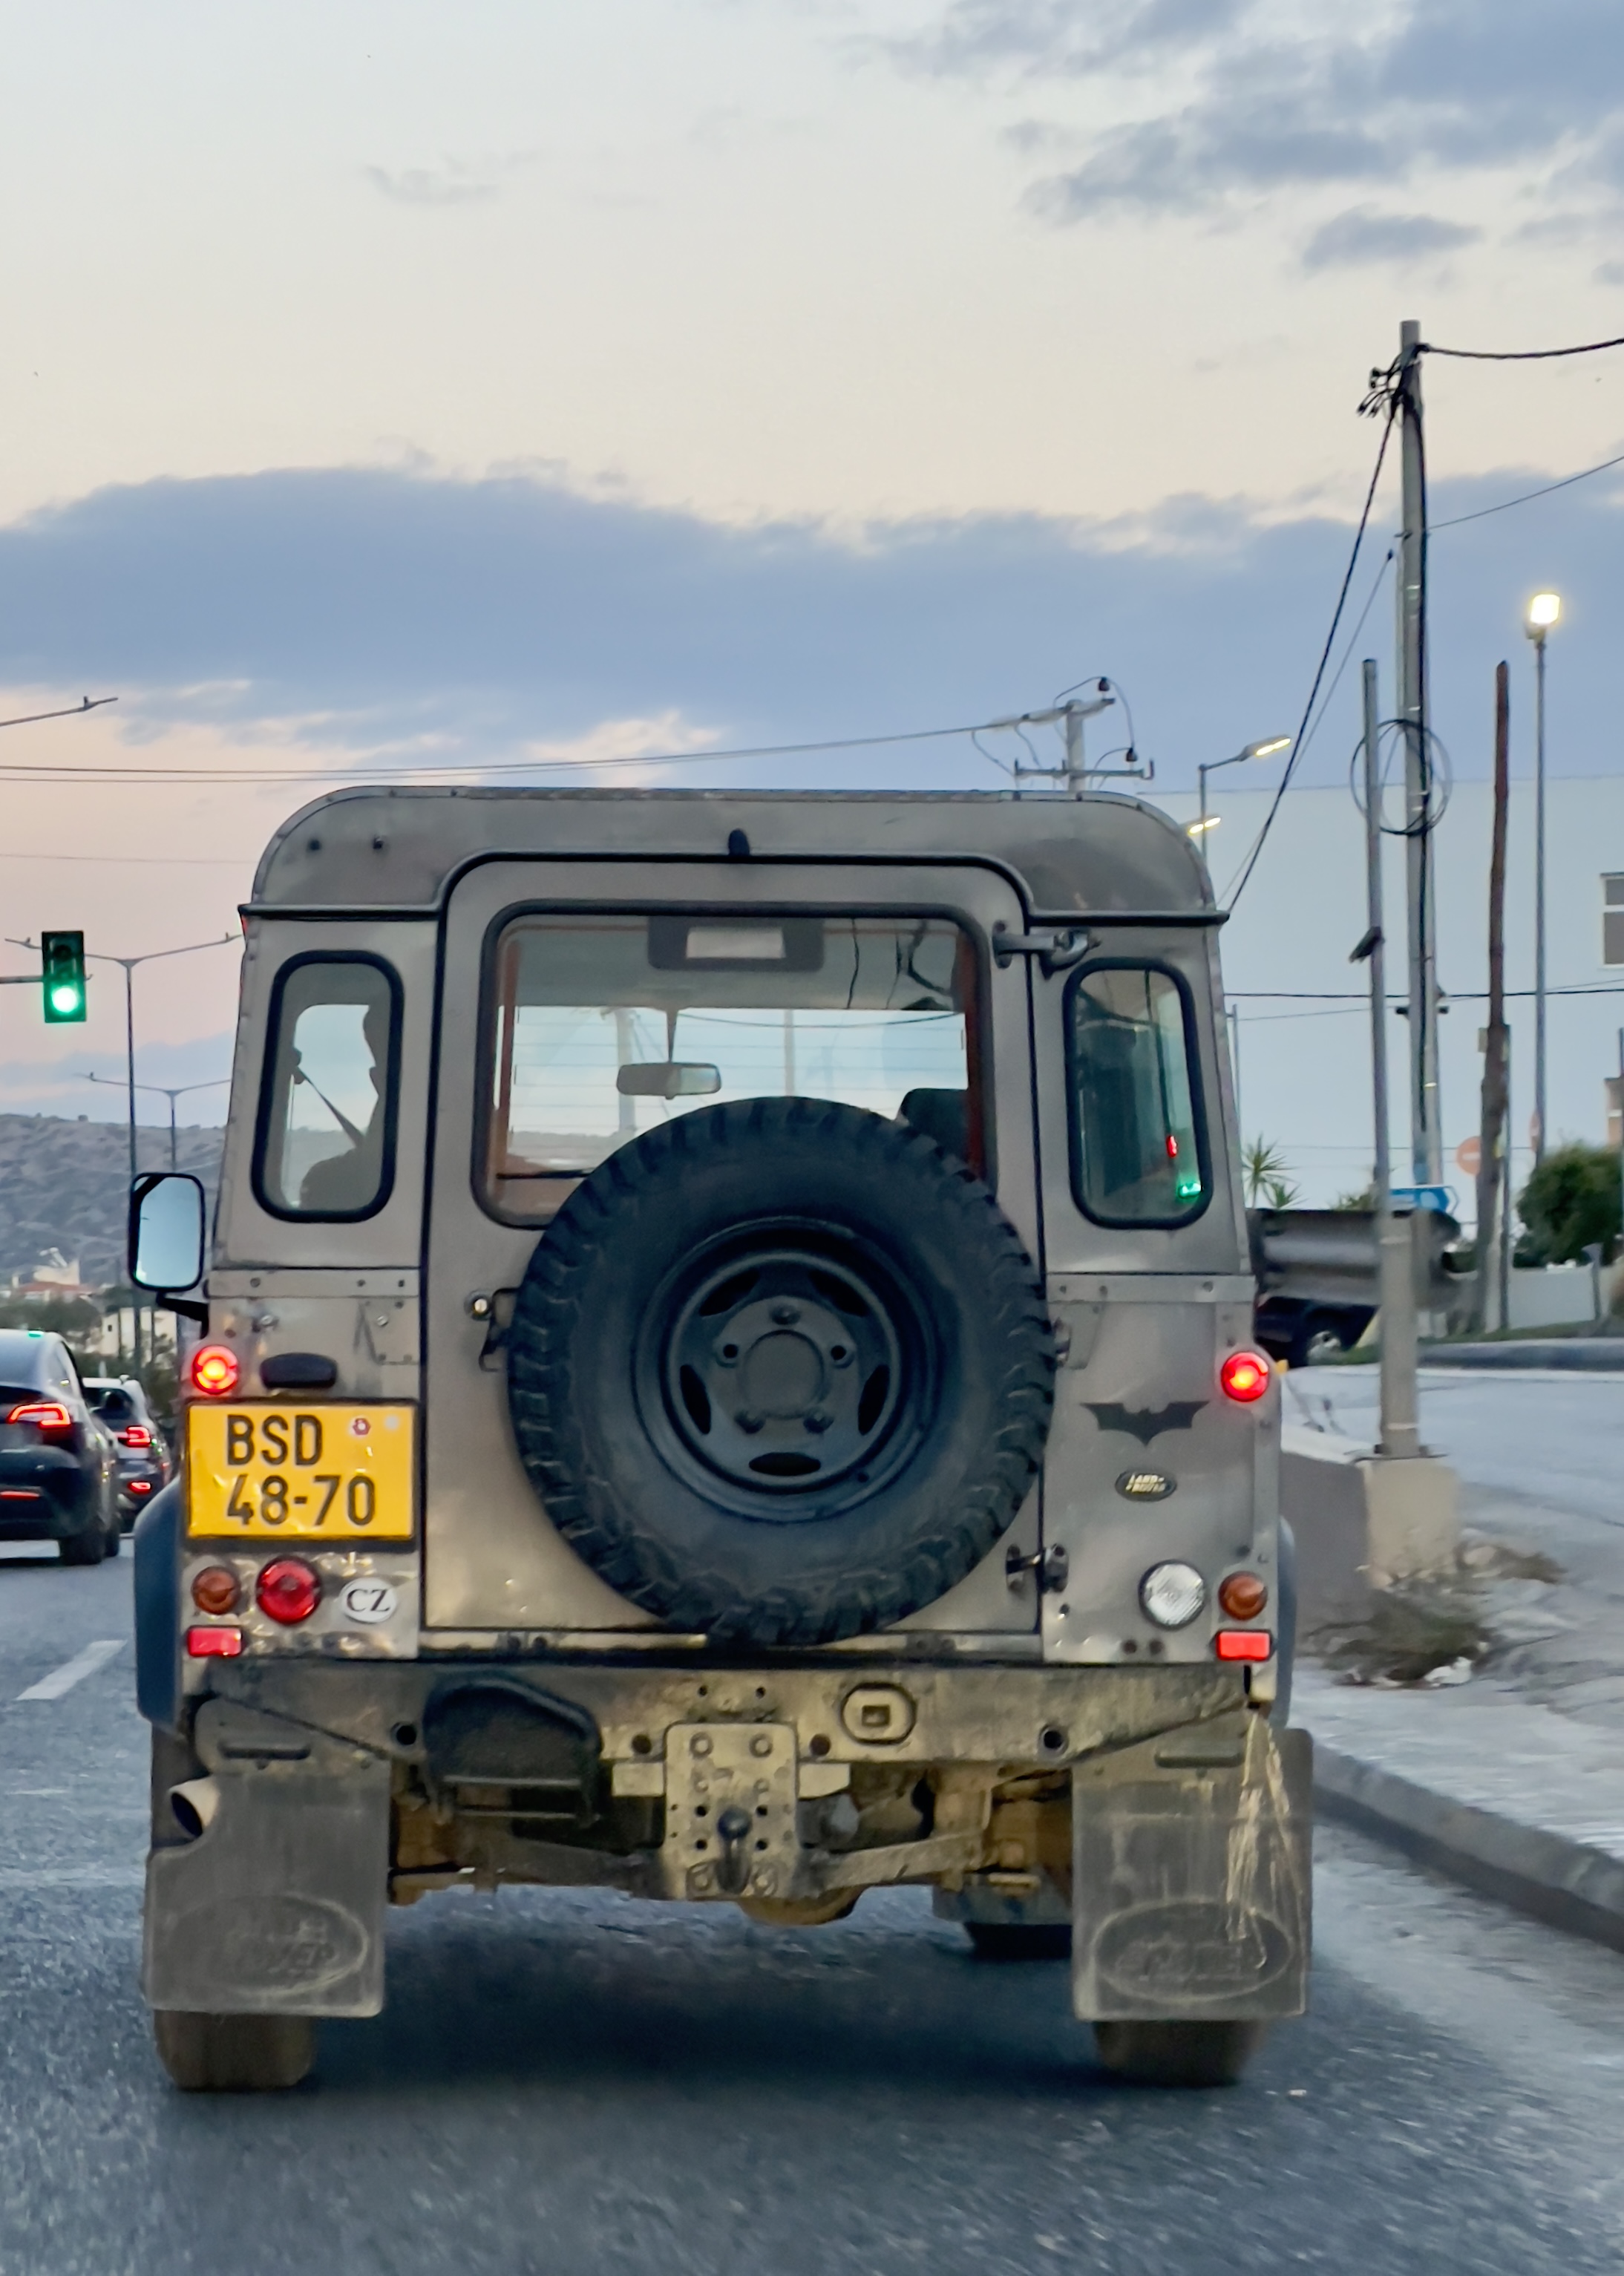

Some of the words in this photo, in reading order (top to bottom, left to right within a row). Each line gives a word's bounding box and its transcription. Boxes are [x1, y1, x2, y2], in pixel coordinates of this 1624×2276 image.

[227, 1414, 323, 1466] BSD
[226, 1474, 376, 1525] 48-70
[347, 1589, 390, 1612] CZ
